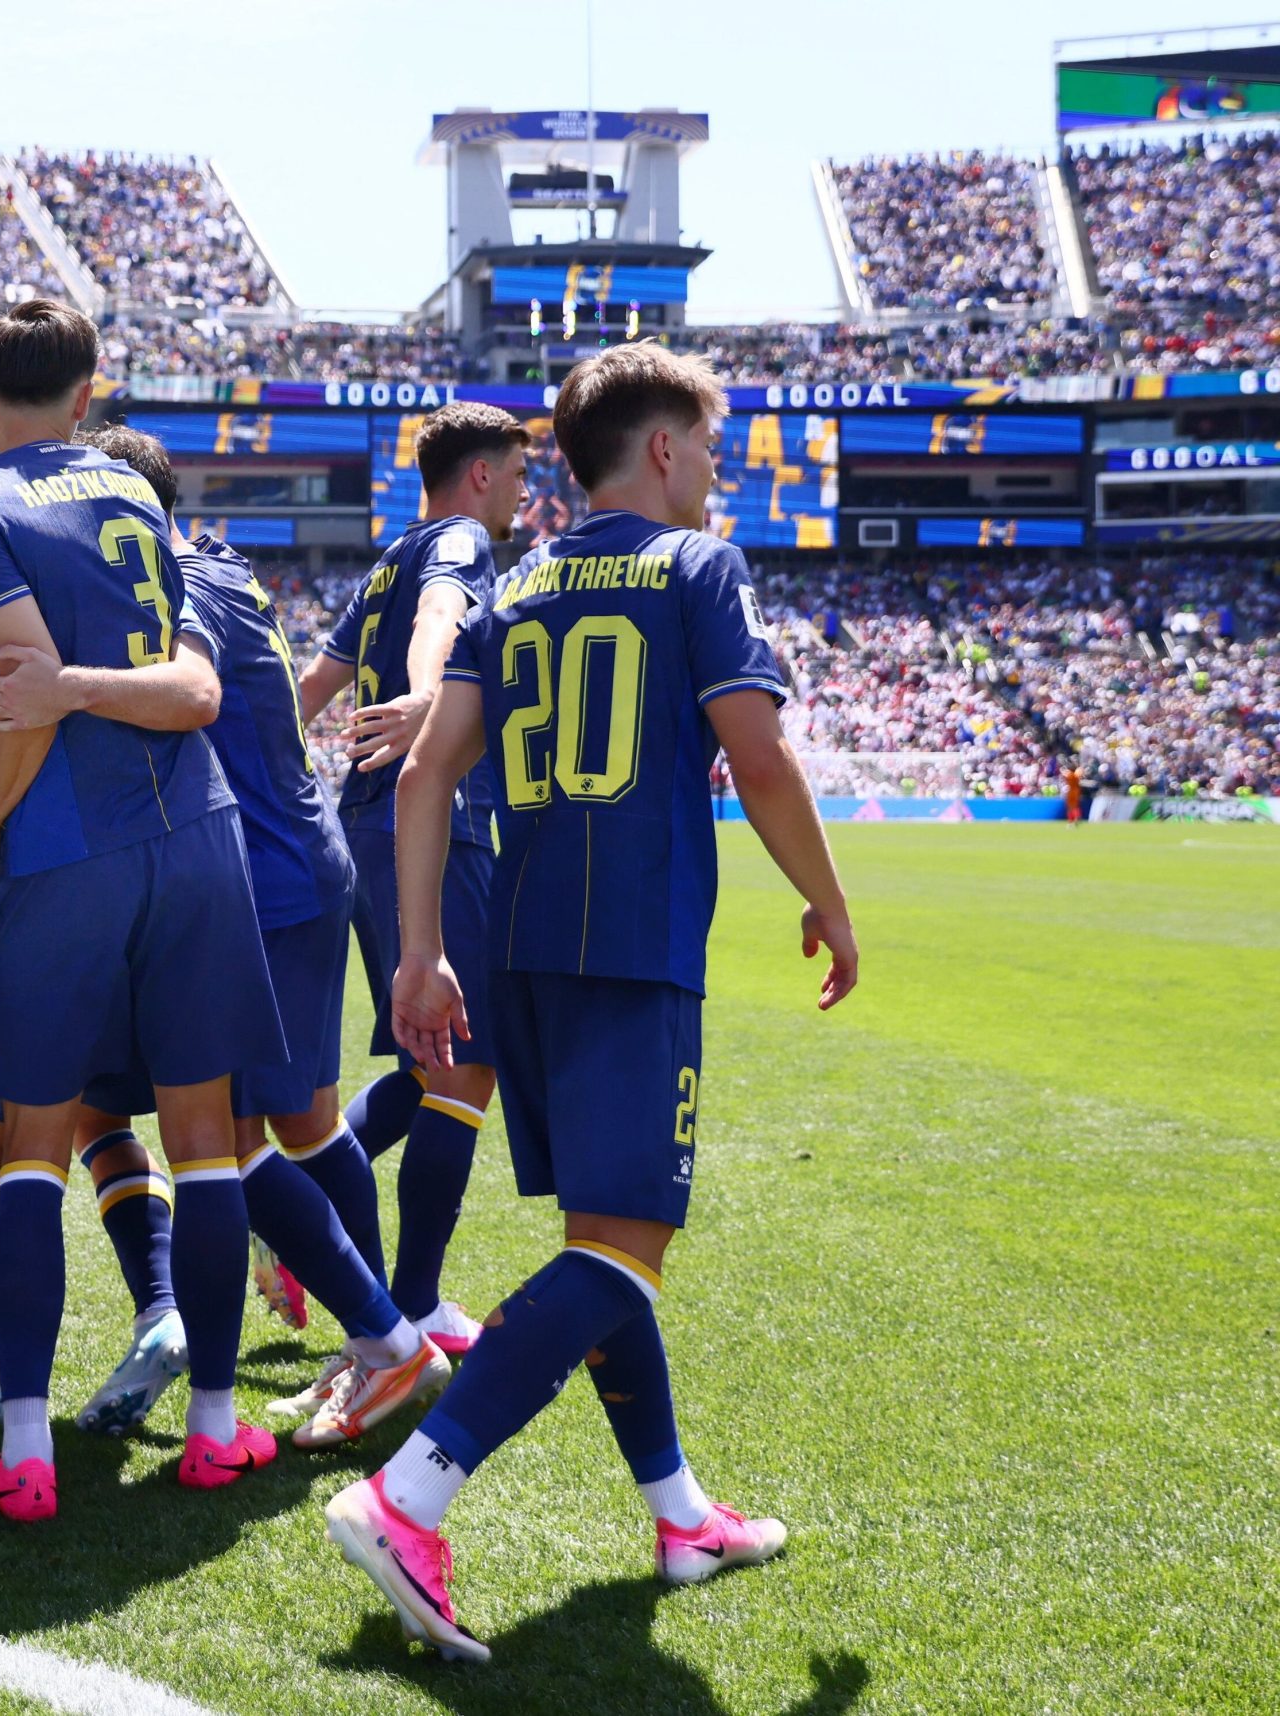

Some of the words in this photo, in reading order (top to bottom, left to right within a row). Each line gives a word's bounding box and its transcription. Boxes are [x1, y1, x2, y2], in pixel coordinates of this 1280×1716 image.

[324, 382, 459, 408] GOOOAL
[766, 383, 911, 408] GOOOAL
[1131, 445, 1262, 470] GOOOAL
[98, 517, 175, 668] 3
[501, 615, 647, 810] 20
[674, 1066, 697, 1147] 2
[672, 1175, 692, 1185] KELM
